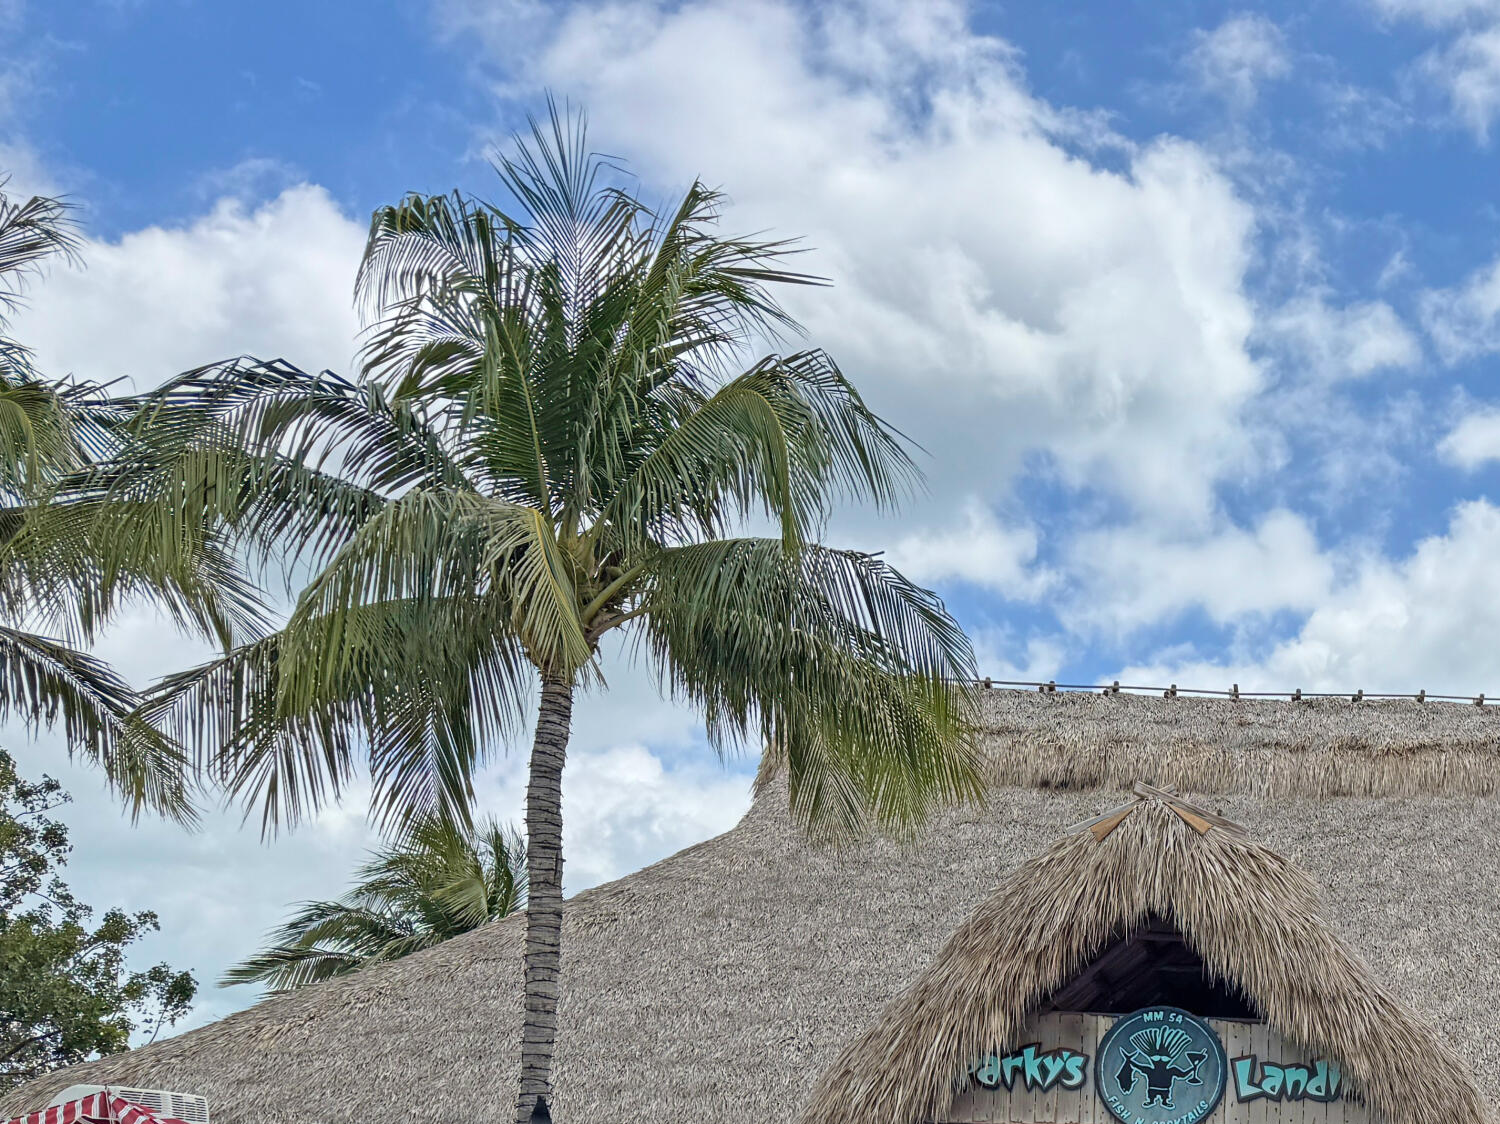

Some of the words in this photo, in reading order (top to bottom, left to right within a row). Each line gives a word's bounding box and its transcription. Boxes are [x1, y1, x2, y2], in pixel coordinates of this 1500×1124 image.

[1143, 1011, 1164, 1023] MM
[1168, 1012, 1183, 1024] 54
[968, 1045, 1085, 1088] arky's
[1108, 1095, 1132, 1120] FISH
